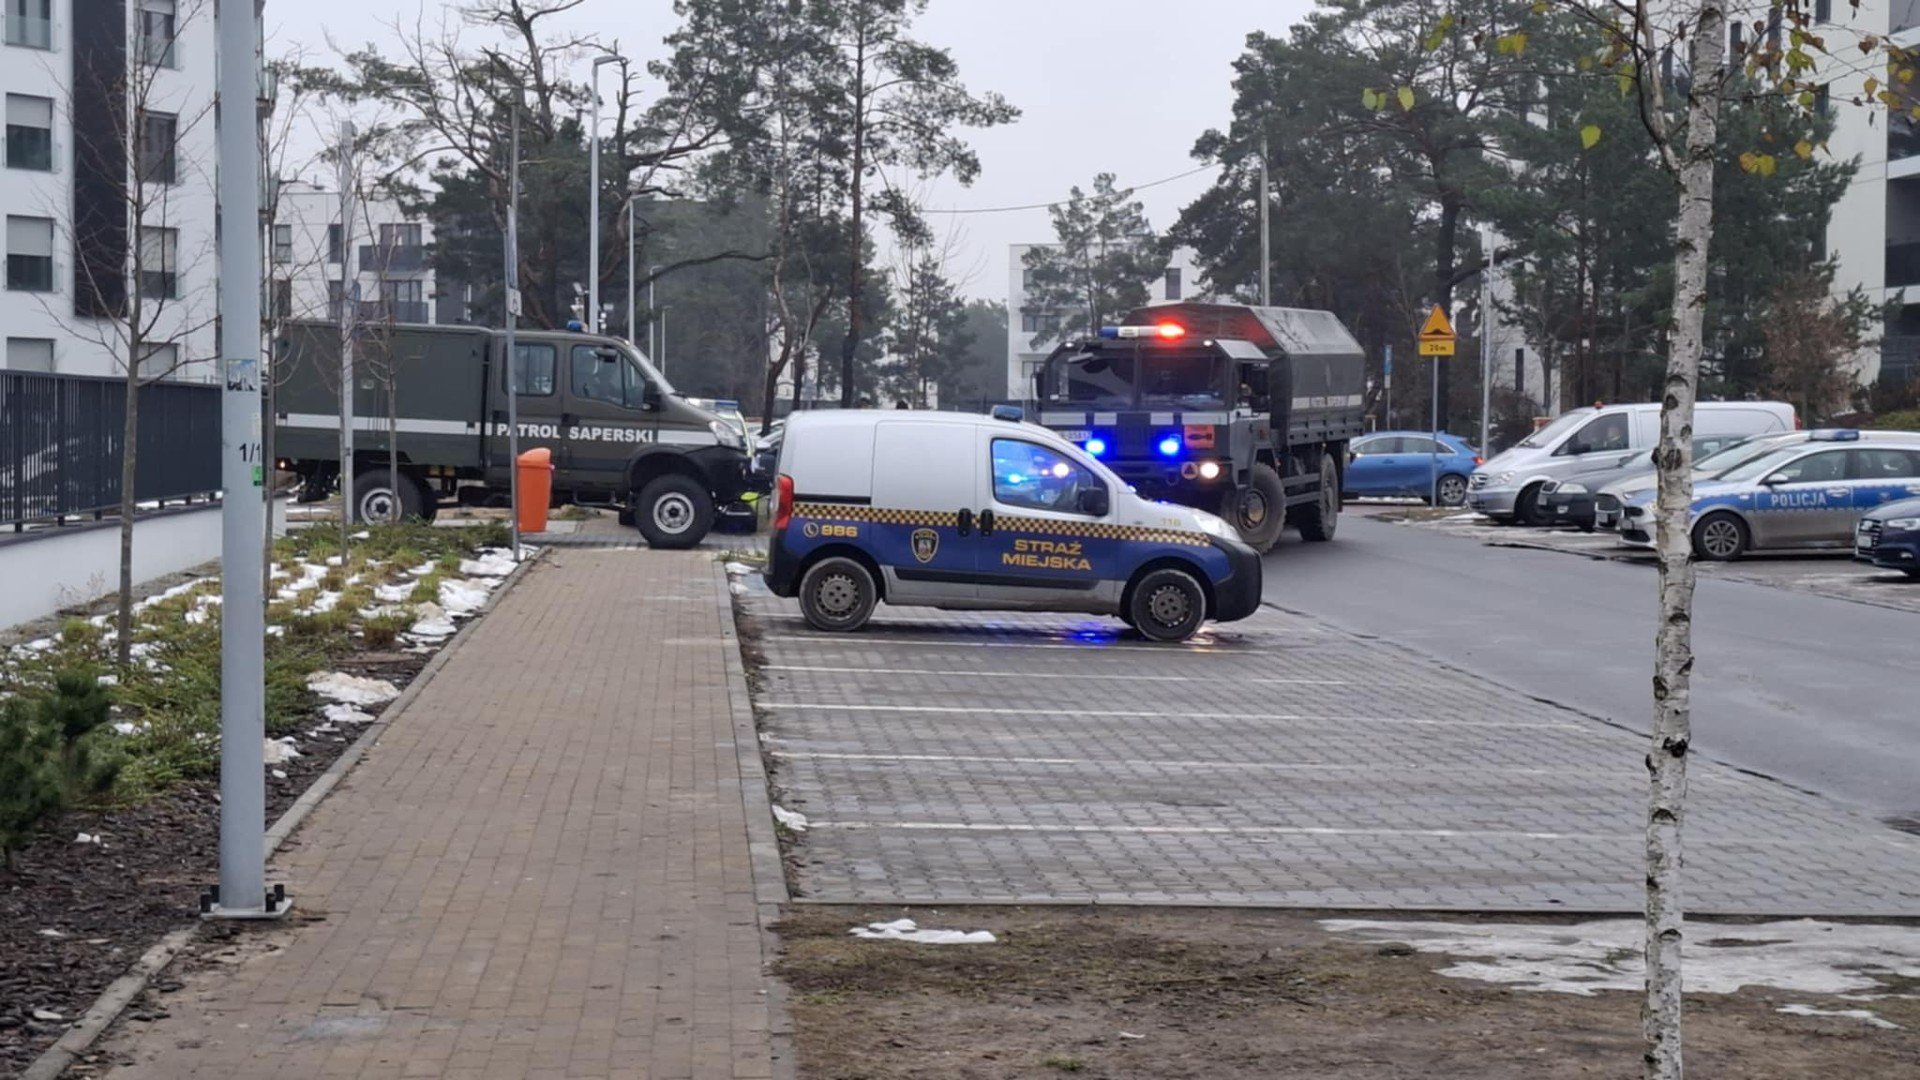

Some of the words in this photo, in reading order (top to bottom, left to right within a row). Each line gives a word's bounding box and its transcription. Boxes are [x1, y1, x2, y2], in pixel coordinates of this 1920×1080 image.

[497, 423, 561, 439] PTROL
[569, 426, 653, 443] SAPERSKI
[1771, 492, 1827, 507] POLICJA
[1014, 539, 1082, 555] STRAŻ
[1002, 552, 1092, 570] MIEJSKA
